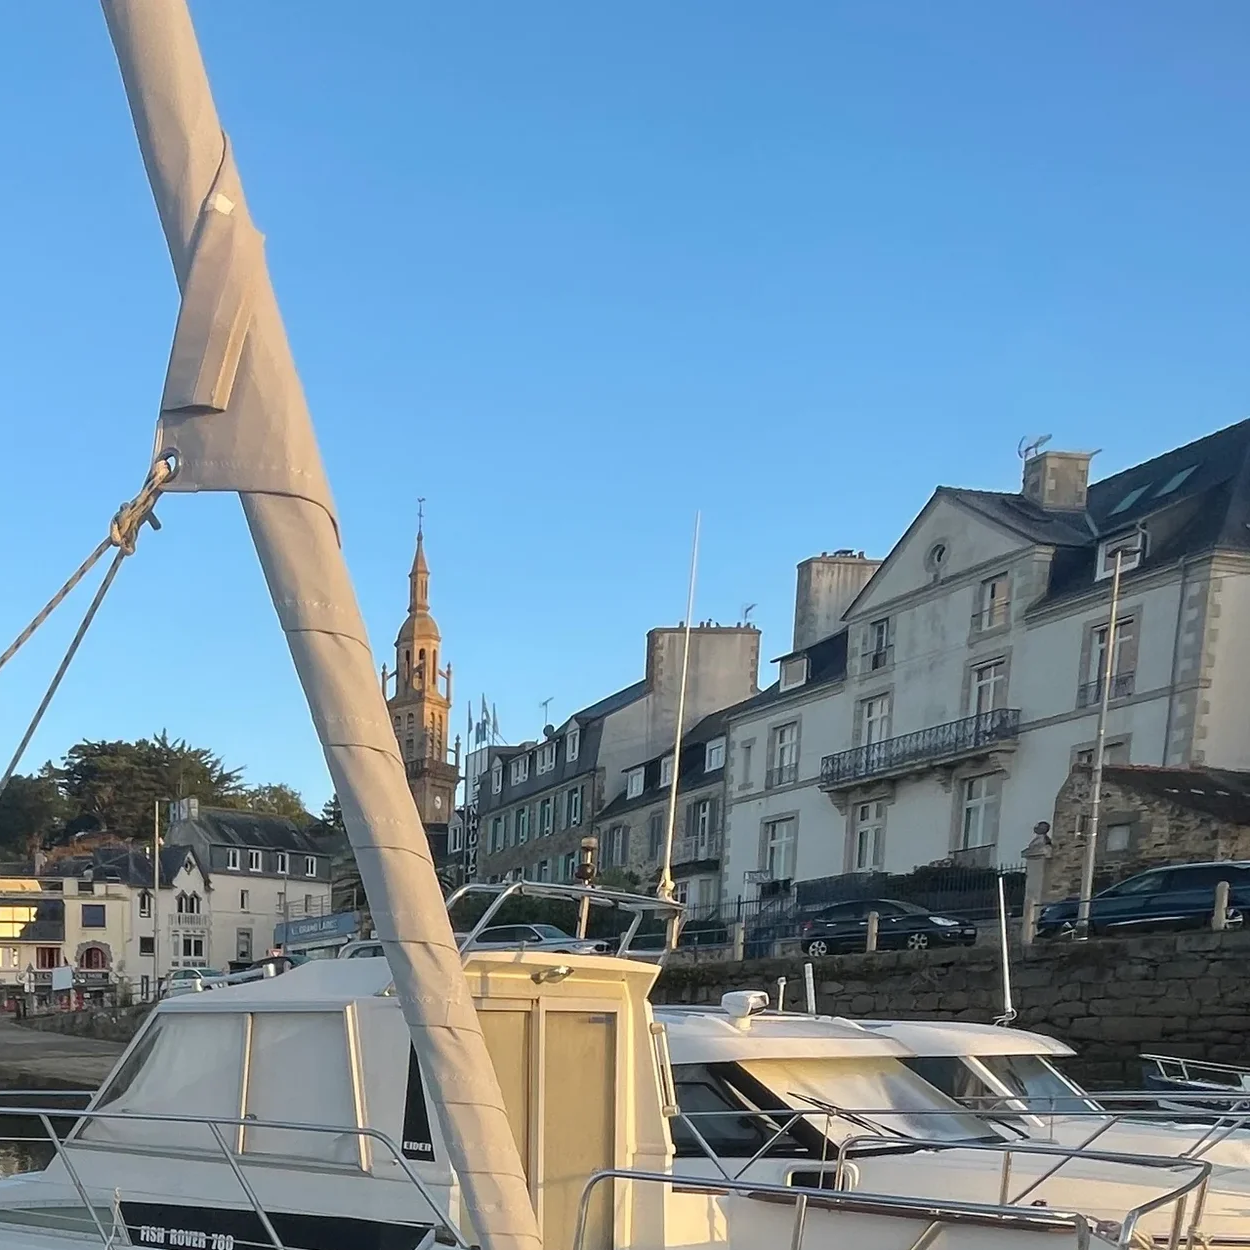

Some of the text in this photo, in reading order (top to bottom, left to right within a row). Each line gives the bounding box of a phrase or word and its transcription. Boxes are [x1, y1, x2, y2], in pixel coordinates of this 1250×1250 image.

[403, 1141, 432, 1152] EIDER
[140, 1225, 165, 1244] FISH
[170, 1228, 206, 1249] ROVER
